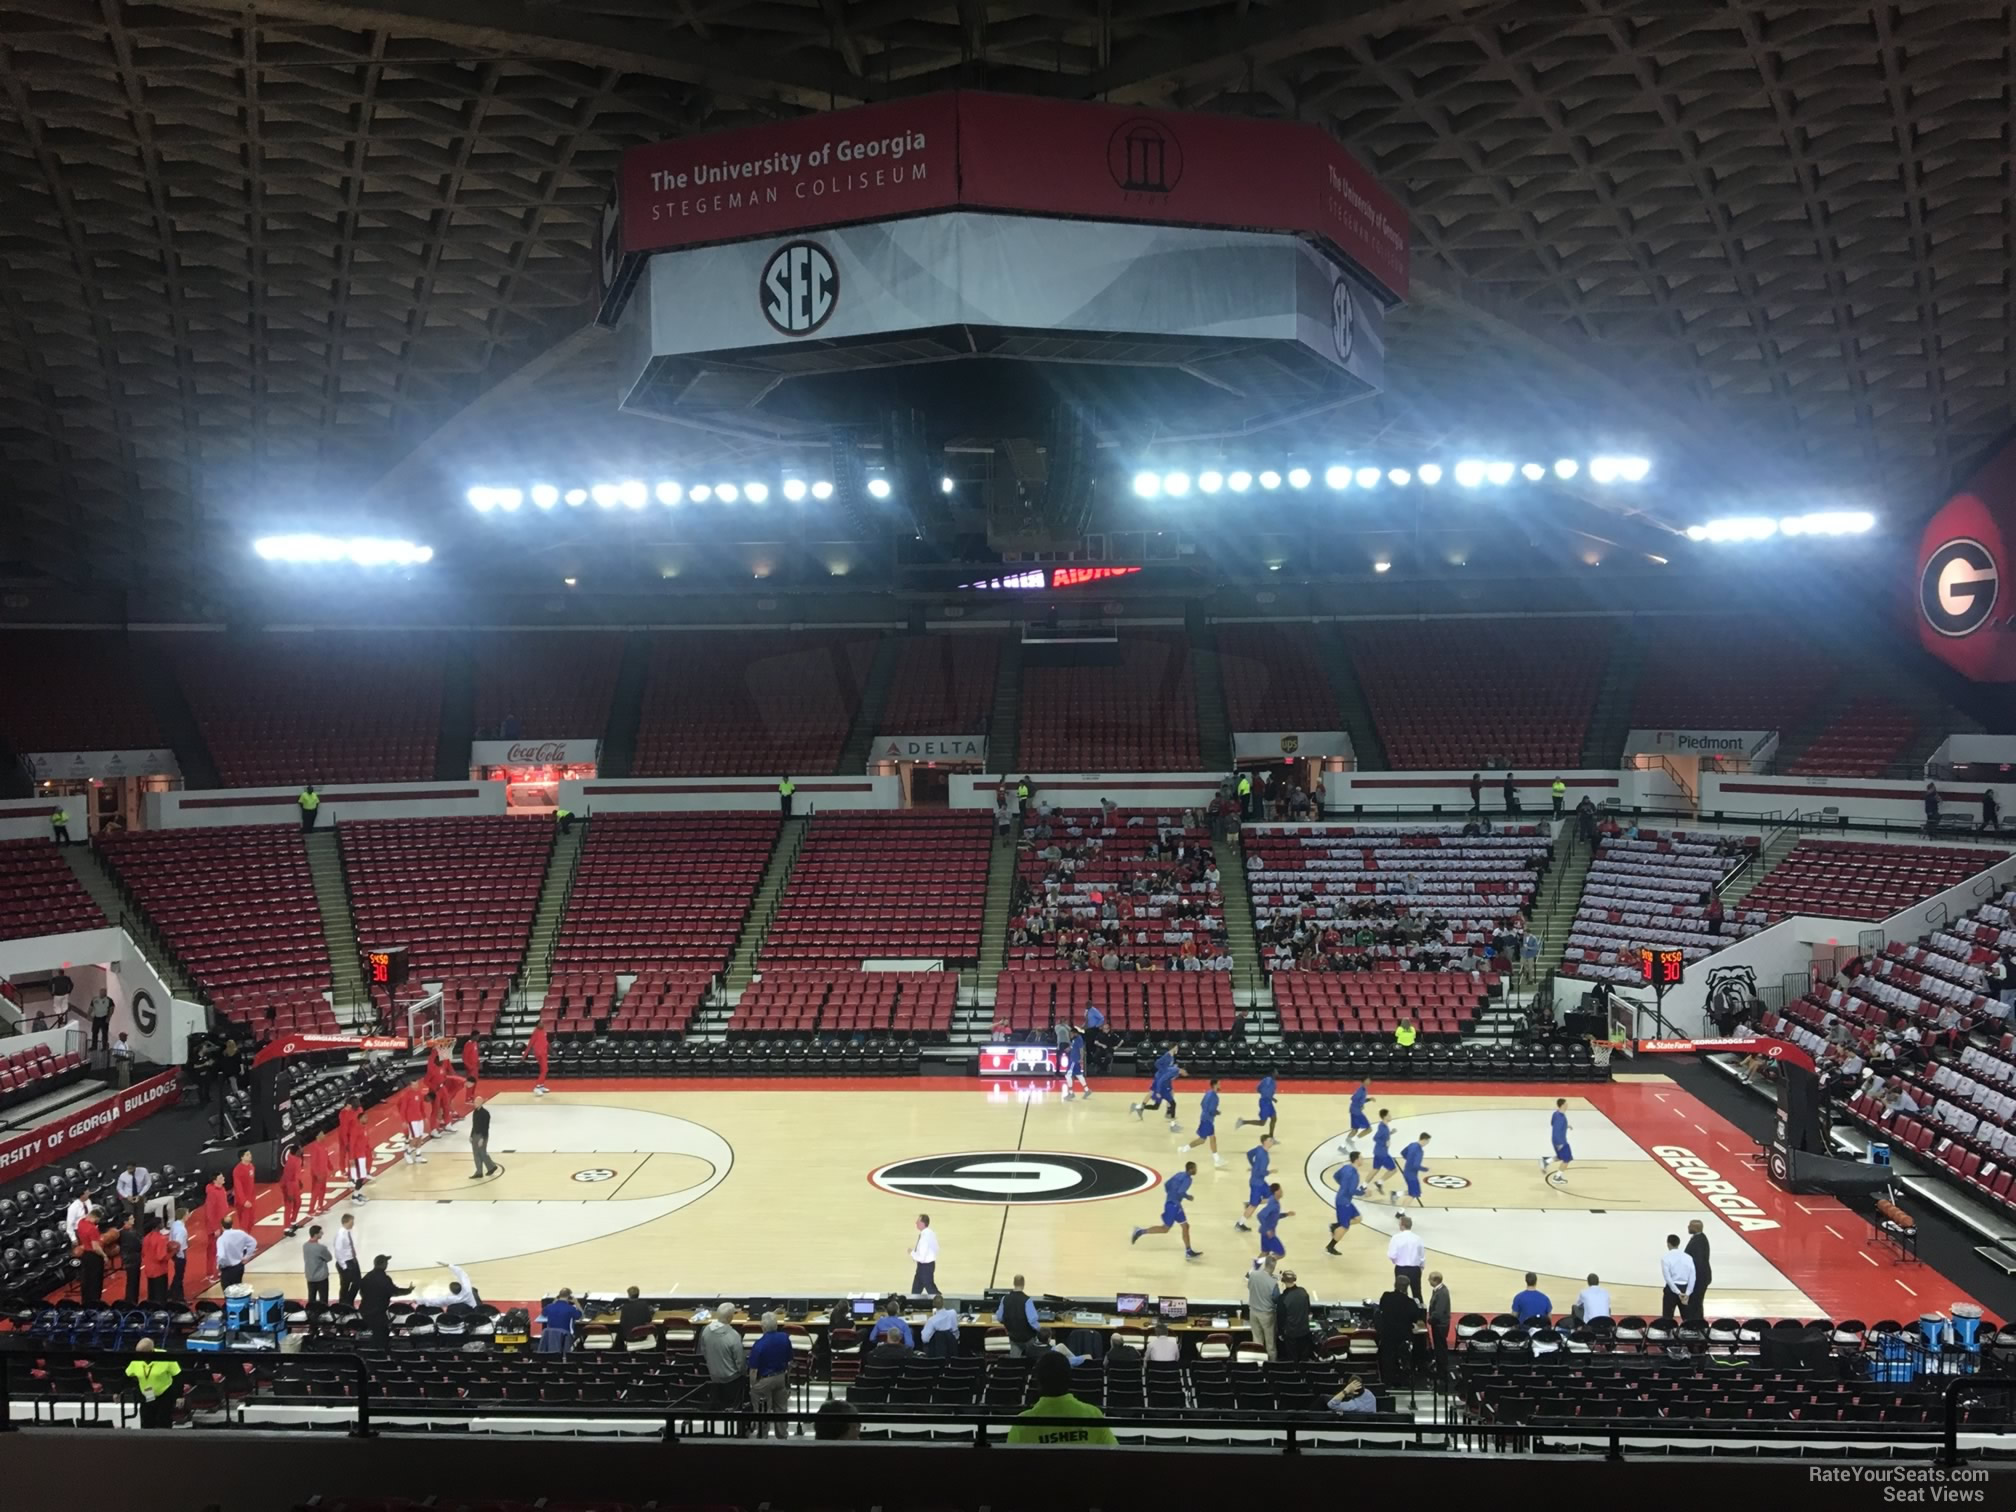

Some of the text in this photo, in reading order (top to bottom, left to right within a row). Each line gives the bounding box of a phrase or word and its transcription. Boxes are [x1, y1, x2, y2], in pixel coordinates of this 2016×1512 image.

[651, 129, 926, 192] The University of Georgia
[651, 163, 927, 221] STEGEMAN COLISEUM
[764, 245, 835, 332] SEC
[507, 742, 567, 763] Coca-Cola
[908, 741, 977, 755] DELTA
[1678, 735, 1744, 750] Piedmont
[373, 964, 388, 982] 30
[1664, 962, 1680, 981] 30
[132, 987, 158, 1038] G
[48, 1130, 64, 1148] OF
[69, 1106, 120, 1139] GEORGIA
[124, 1078, 177, 1112] BULLDOGS
[1652, 1146, 1781, 1231] GEORGIA
[1038, 1430, 1089, 1444] USHER
